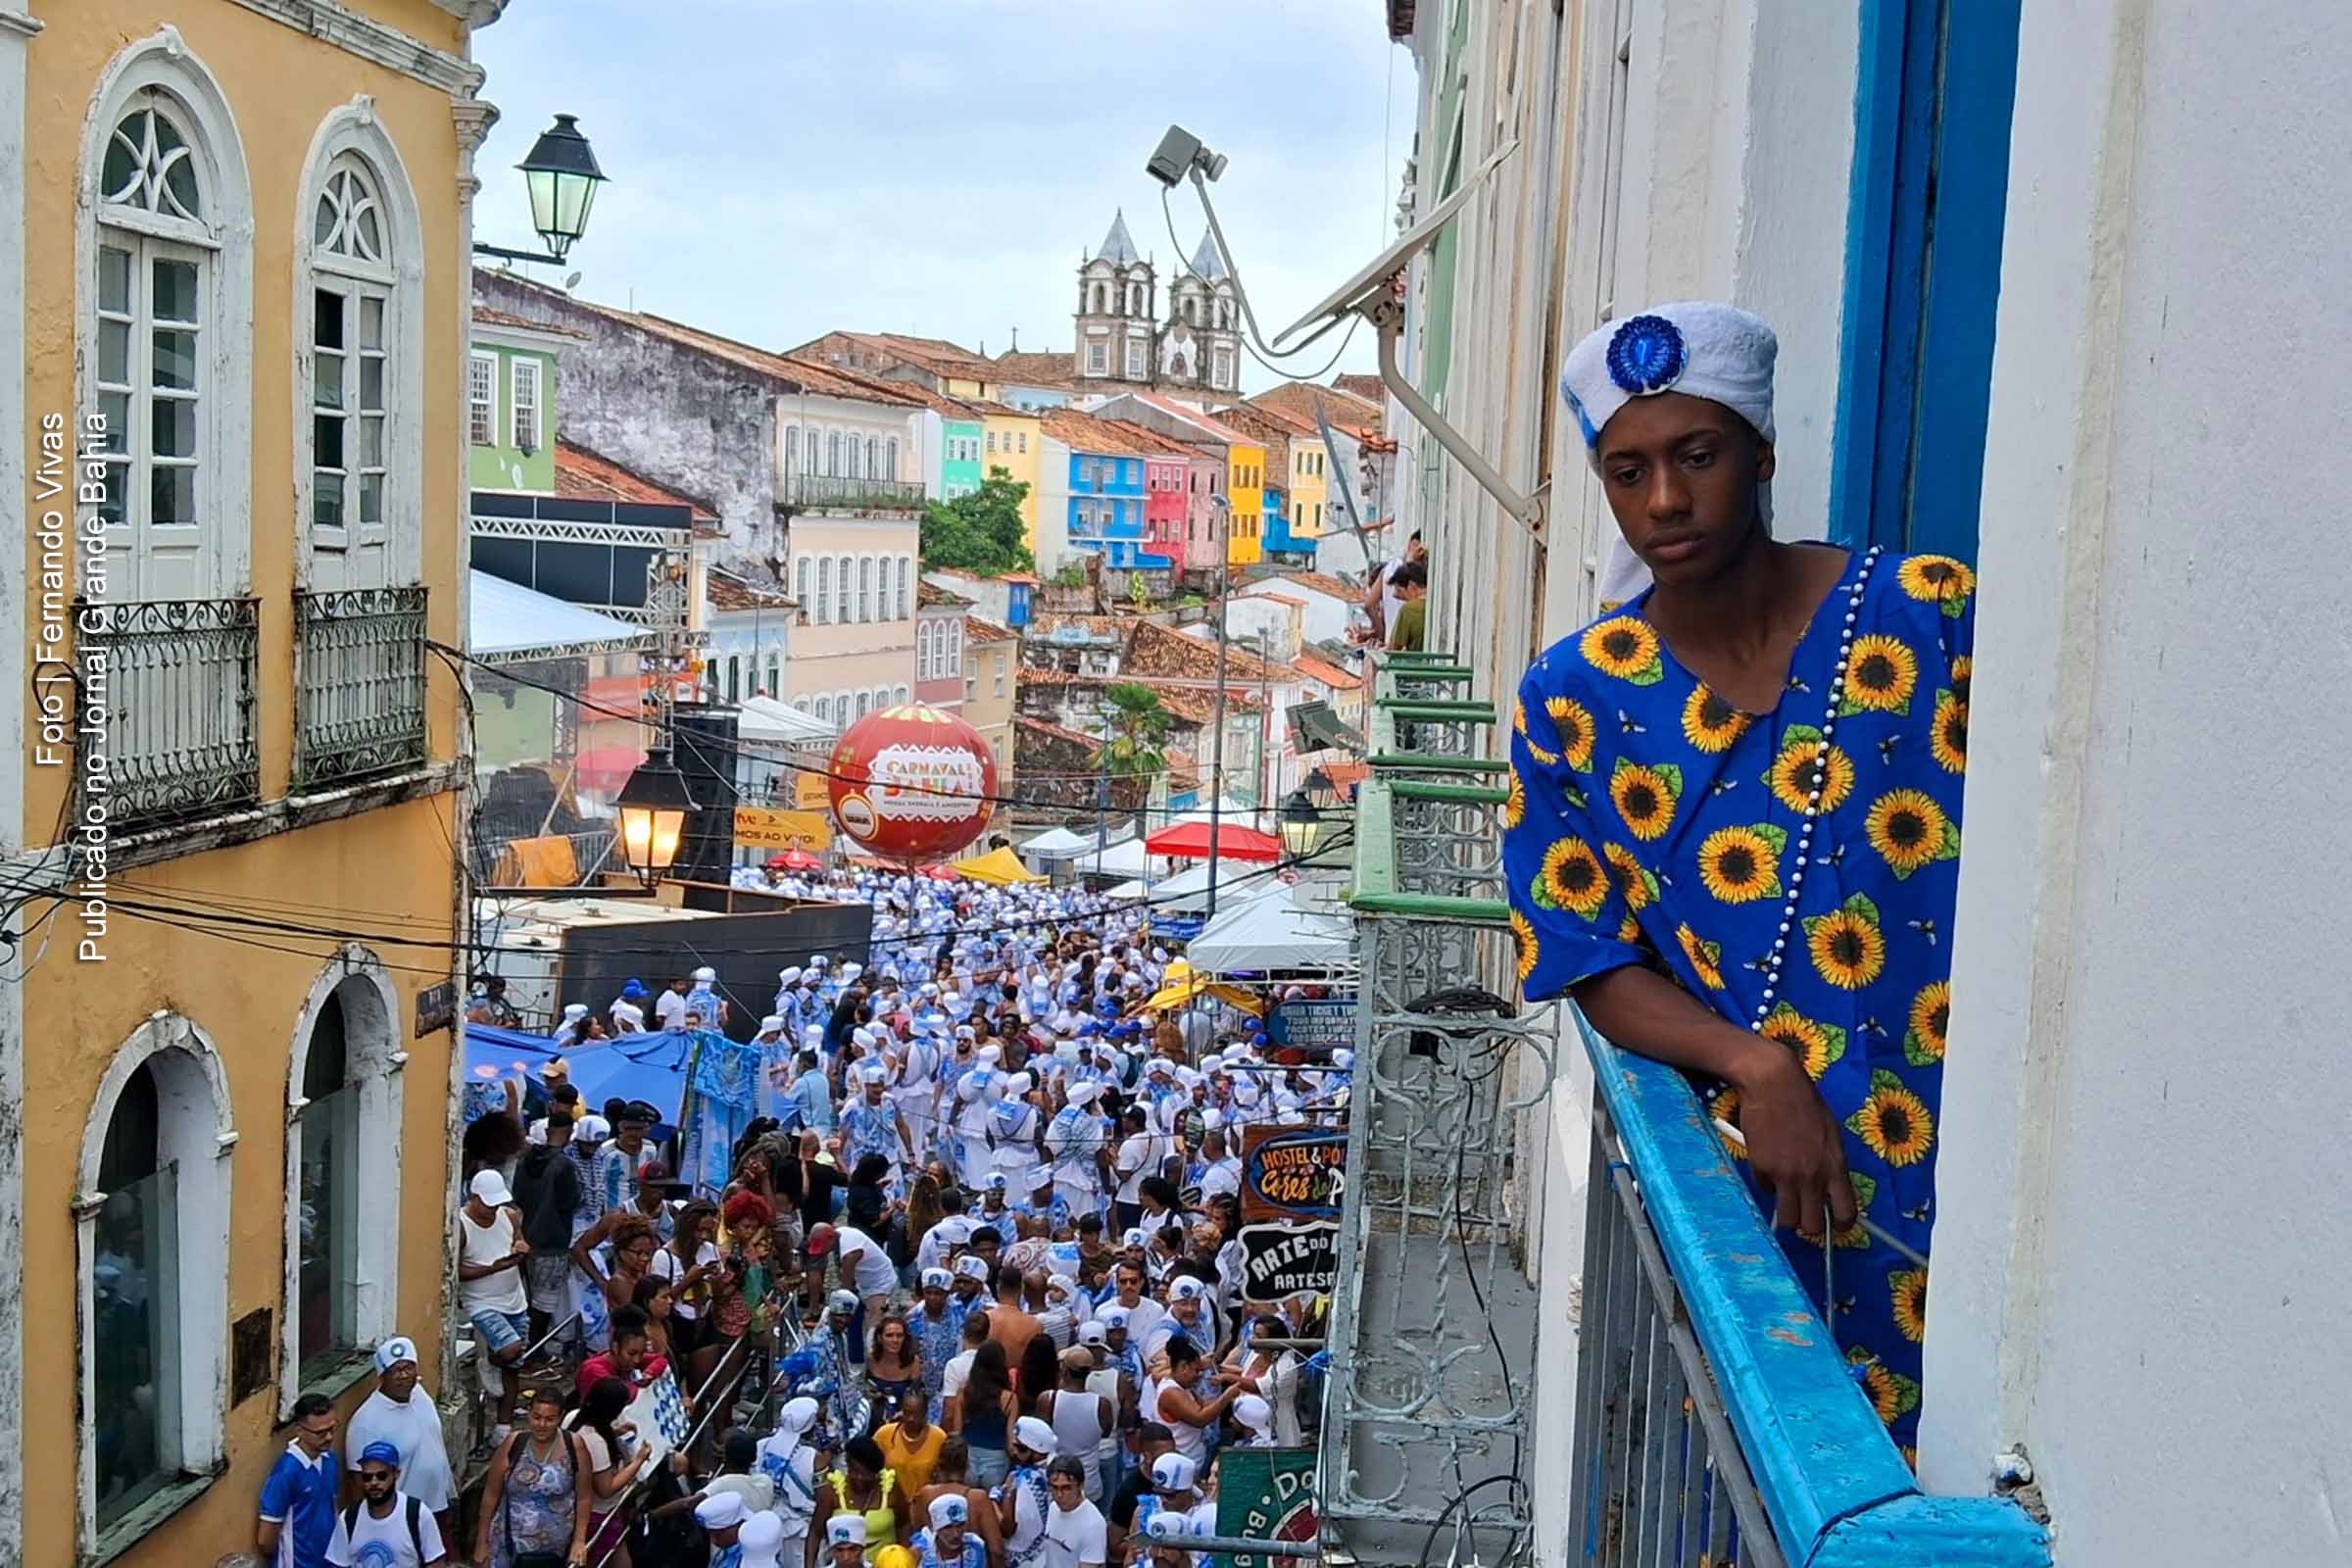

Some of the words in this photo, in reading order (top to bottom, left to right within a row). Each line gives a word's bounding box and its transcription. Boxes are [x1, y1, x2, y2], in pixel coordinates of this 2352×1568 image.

[887, 760, 965, 775] CARNAVAL
[1260, 1148, 1308, 1170] HOSTEL
[1311, 1147, 1325, 1169] &
[1250, 1235, 1309, 1282] ARTE
[1309, 1238, 1329, 1250] DO
